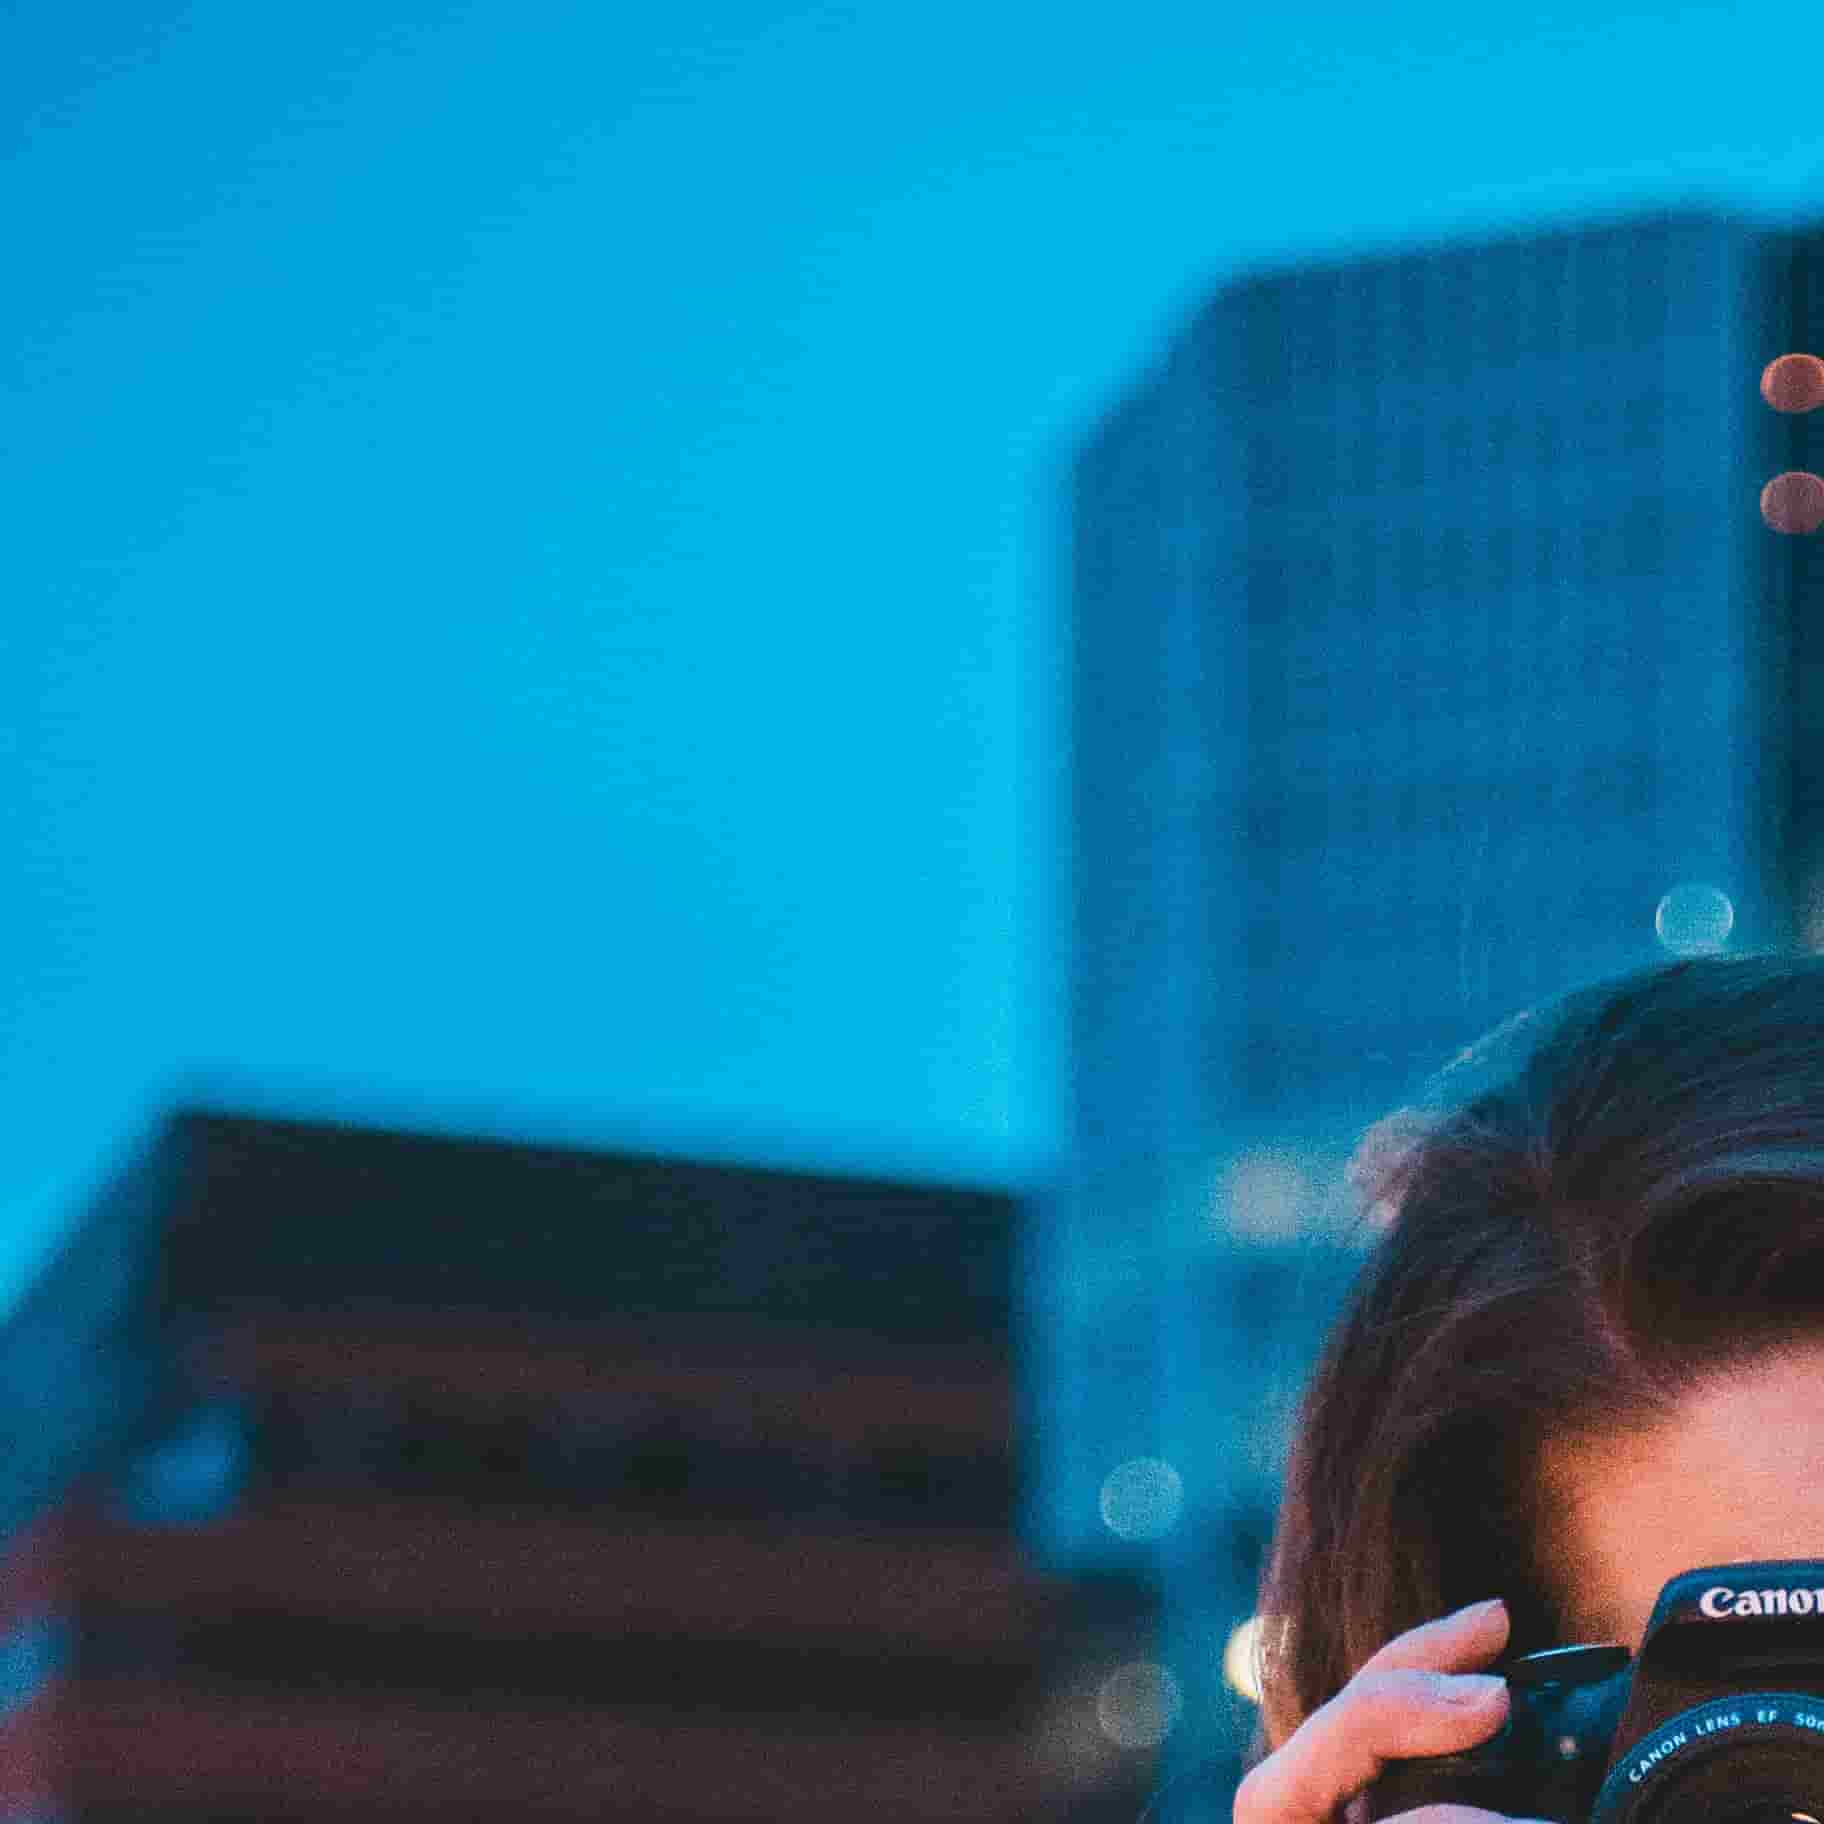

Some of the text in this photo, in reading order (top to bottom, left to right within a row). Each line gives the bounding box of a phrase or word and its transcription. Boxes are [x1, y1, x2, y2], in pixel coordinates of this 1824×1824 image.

[1629, 1731, 1687, 1783] CANON
[1695, 1711, 1741, 1736] LENS
[1757, 1709, 1777, 1723] EF
